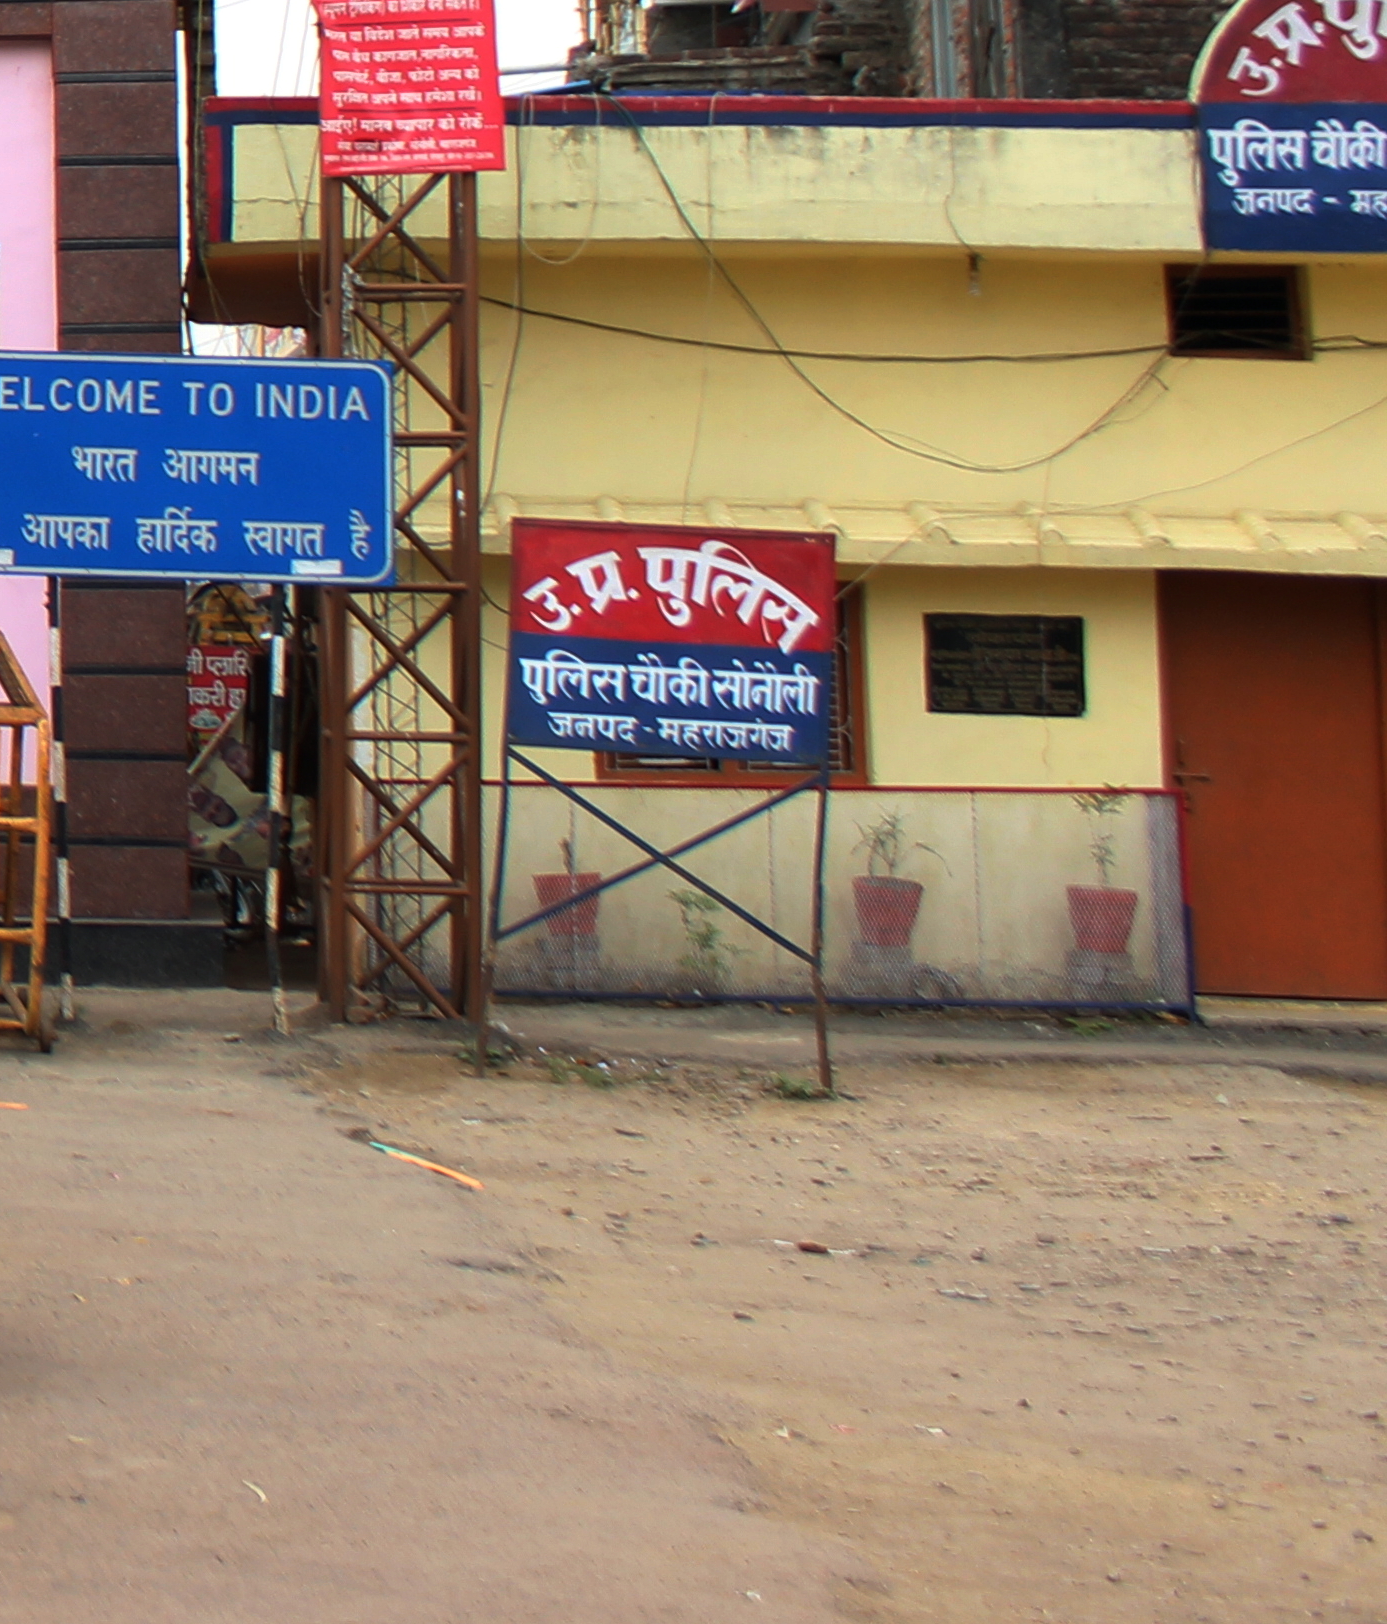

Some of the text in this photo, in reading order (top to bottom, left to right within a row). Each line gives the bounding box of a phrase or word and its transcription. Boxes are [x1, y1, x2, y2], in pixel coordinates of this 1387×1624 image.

[1207, 119, 1307, 187] पुलिस
[1232, 188, 1316, 216] जनपद
[183, 381, 234, 416] TO
[255, 383, 370, 421] INDIA
[71, 445, 260, 485] भारत आगमन
[21, 513, 110, 551] आपका
[135, 506, 218, 554] हार्दिक
[243, 520, 325, 557] स्वागत
[349, 509, 371, 560] है
[636, 539, 820, 656] पुलिस
[519, 648, 627, 705] पुलिस
[628, 652, 714, 708] चौकी
[547, 711, 639, 745] जनपद
